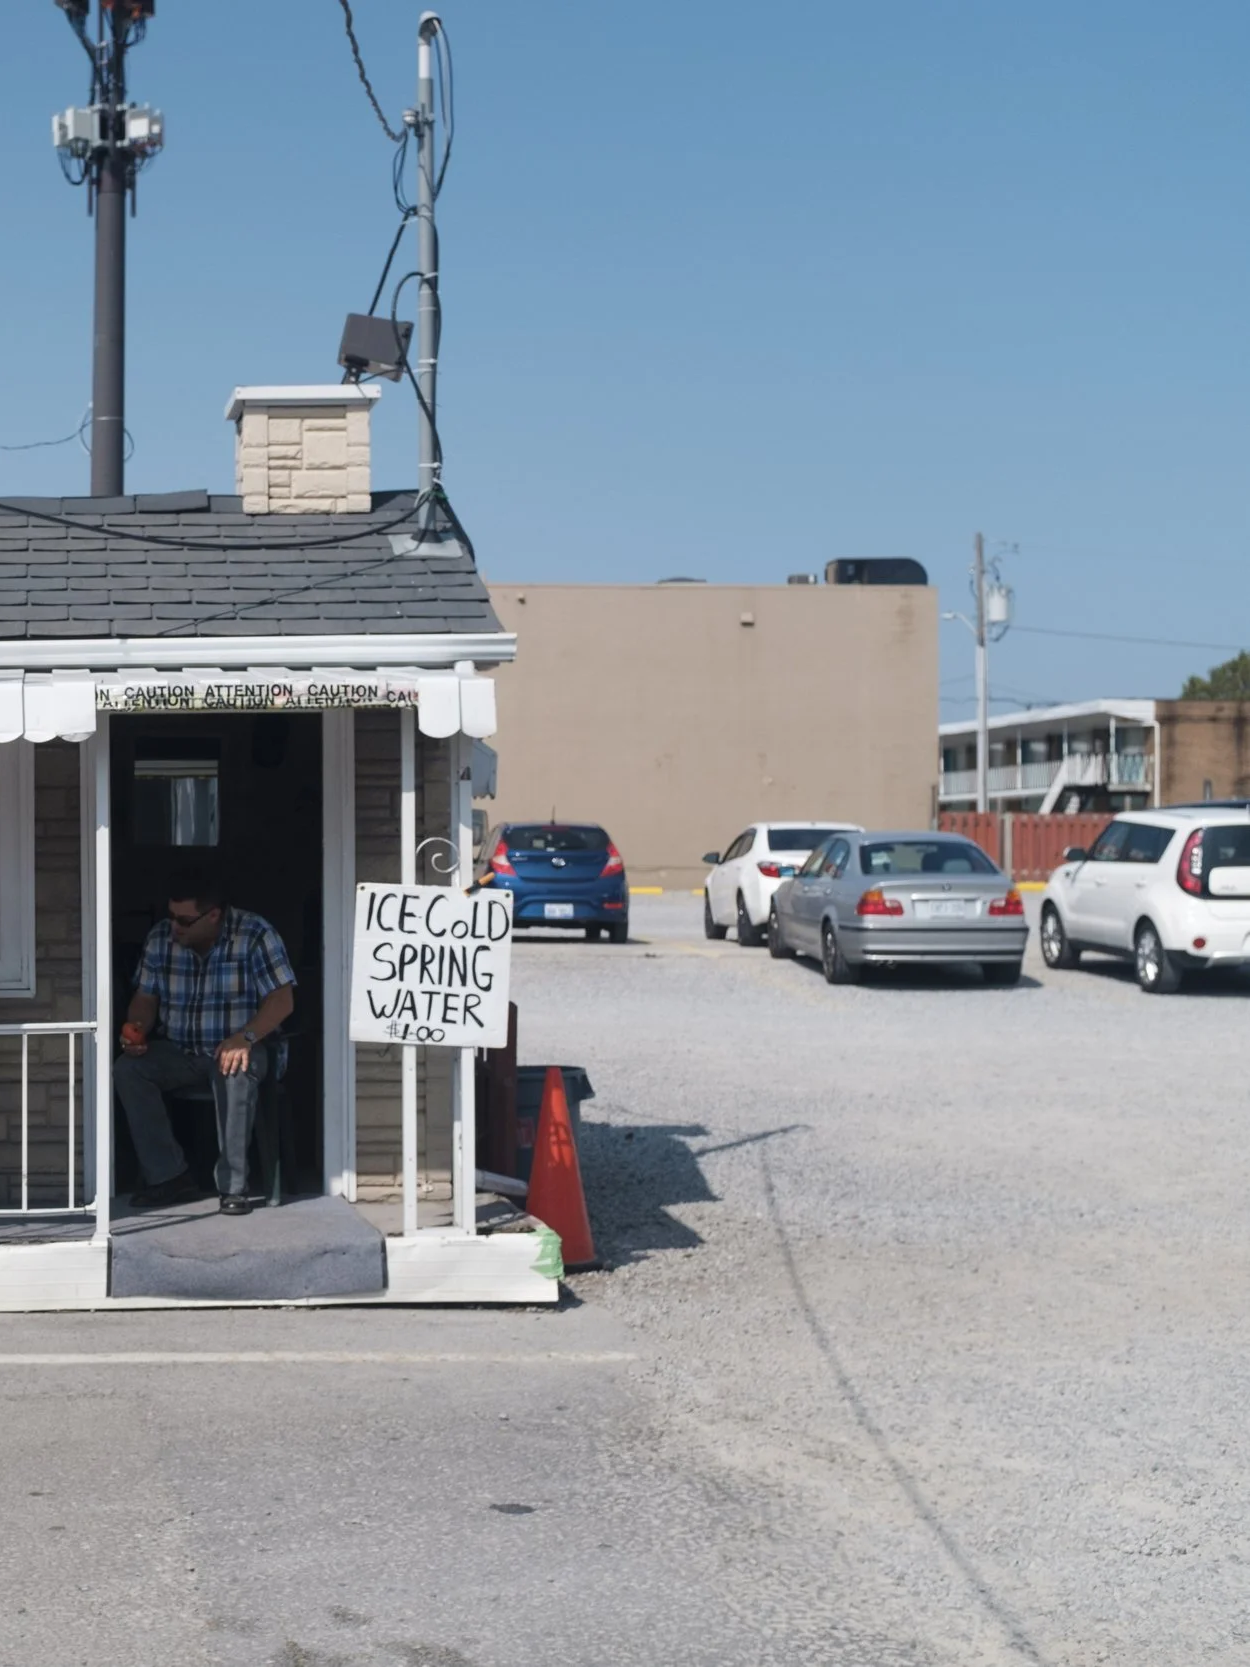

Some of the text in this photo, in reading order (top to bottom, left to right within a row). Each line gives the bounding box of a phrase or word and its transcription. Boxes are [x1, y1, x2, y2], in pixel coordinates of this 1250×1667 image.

[124, 685, 194, 699] CAUTION
[205, 684, 292, 697] ATTENTION
[307, 684, 378, 697] CAUTION
[369, 942, 495, 992] SPRING
[366, 988, 485, 1028] WATER
